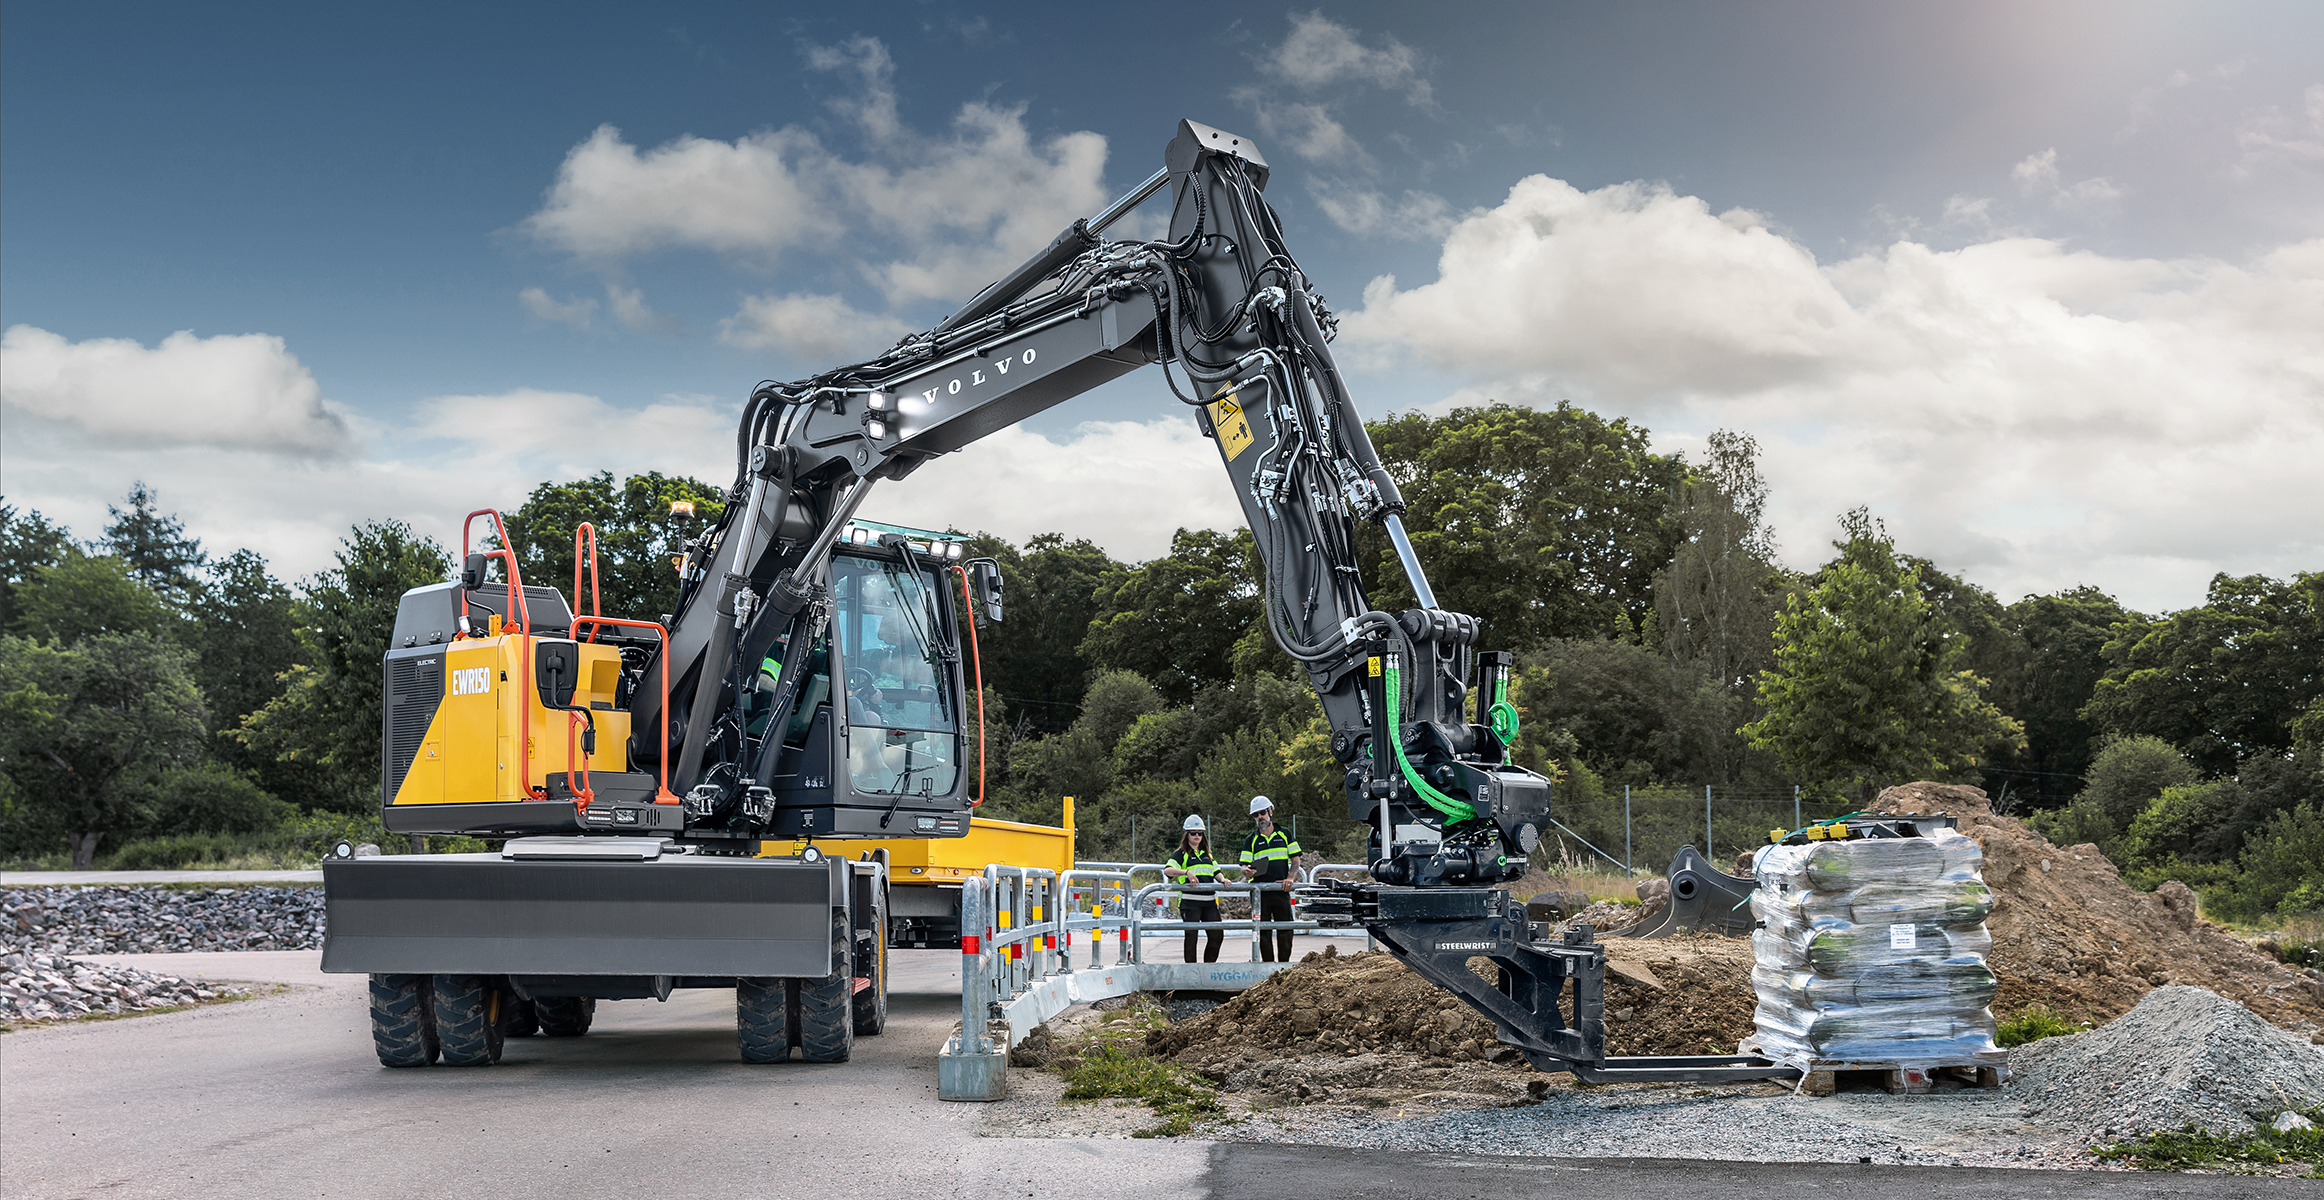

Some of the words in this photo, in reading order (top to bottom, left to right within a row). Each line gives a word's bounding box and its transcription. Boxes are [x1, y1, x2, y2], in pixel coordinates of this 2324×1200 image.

[922, 348, 1037, 405] VOLVO
[452, 666, 491, 696] EWR150
[1441, 942, 1491, 950] STEELWRIST
